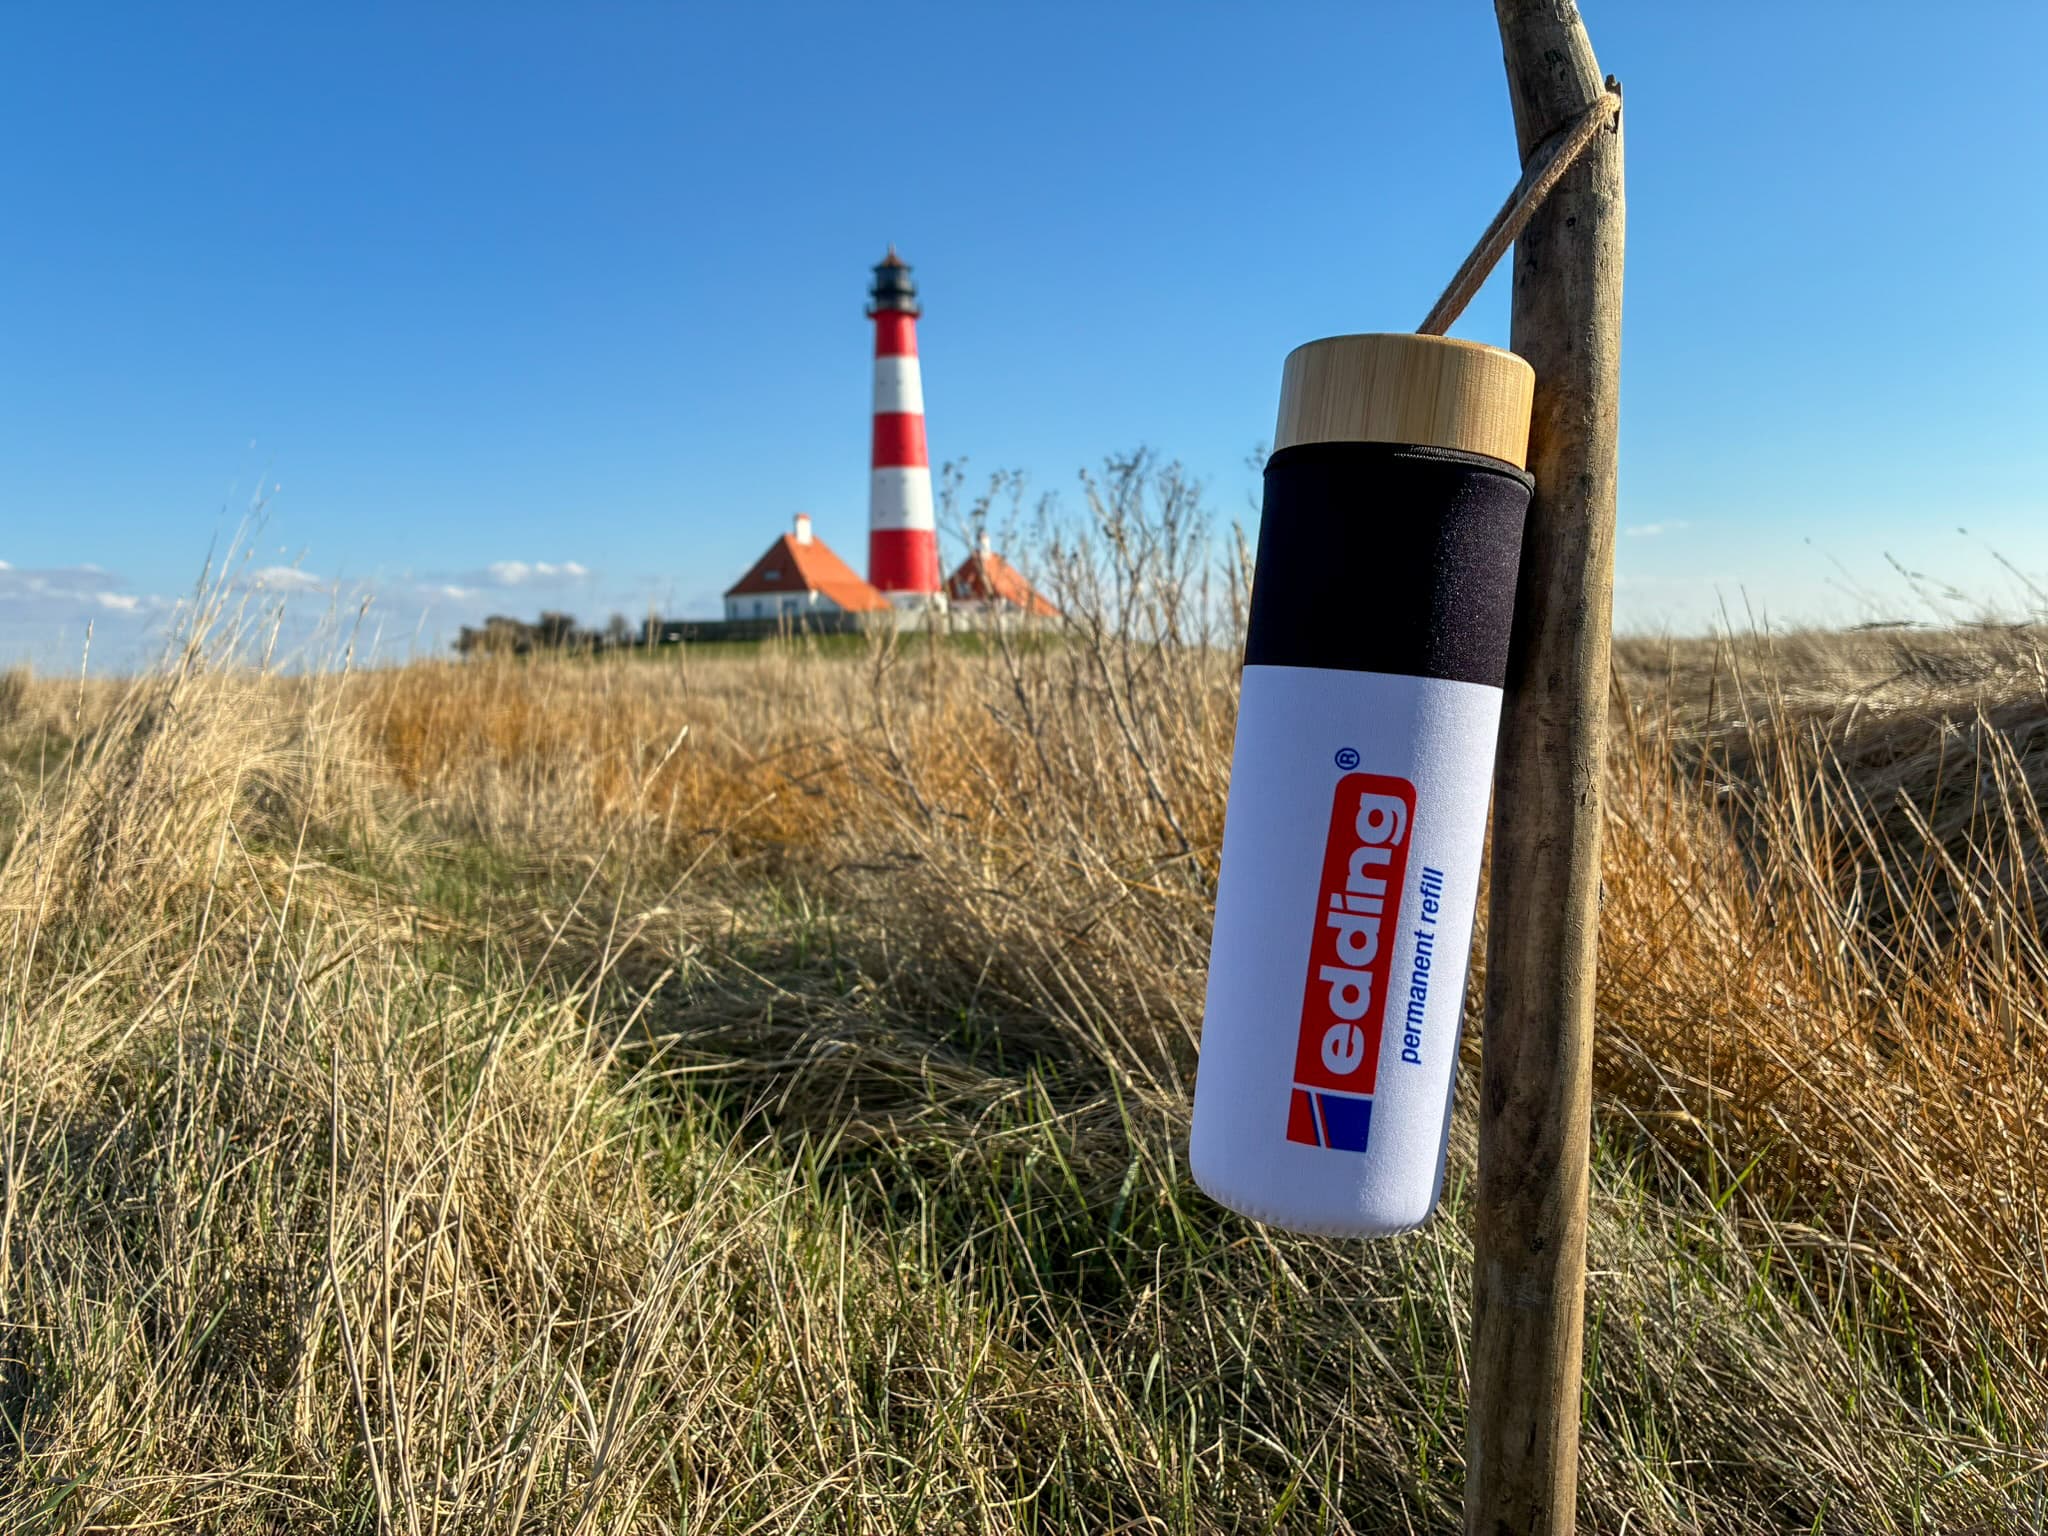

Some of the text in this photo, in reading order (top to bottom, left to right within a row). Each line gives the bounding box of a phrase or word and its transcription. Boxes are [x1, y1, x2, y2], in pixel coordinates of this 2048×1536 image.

[1319, 792, 1408, 1076] edding
[1401, 866, 1444, 1065] permanent refill
